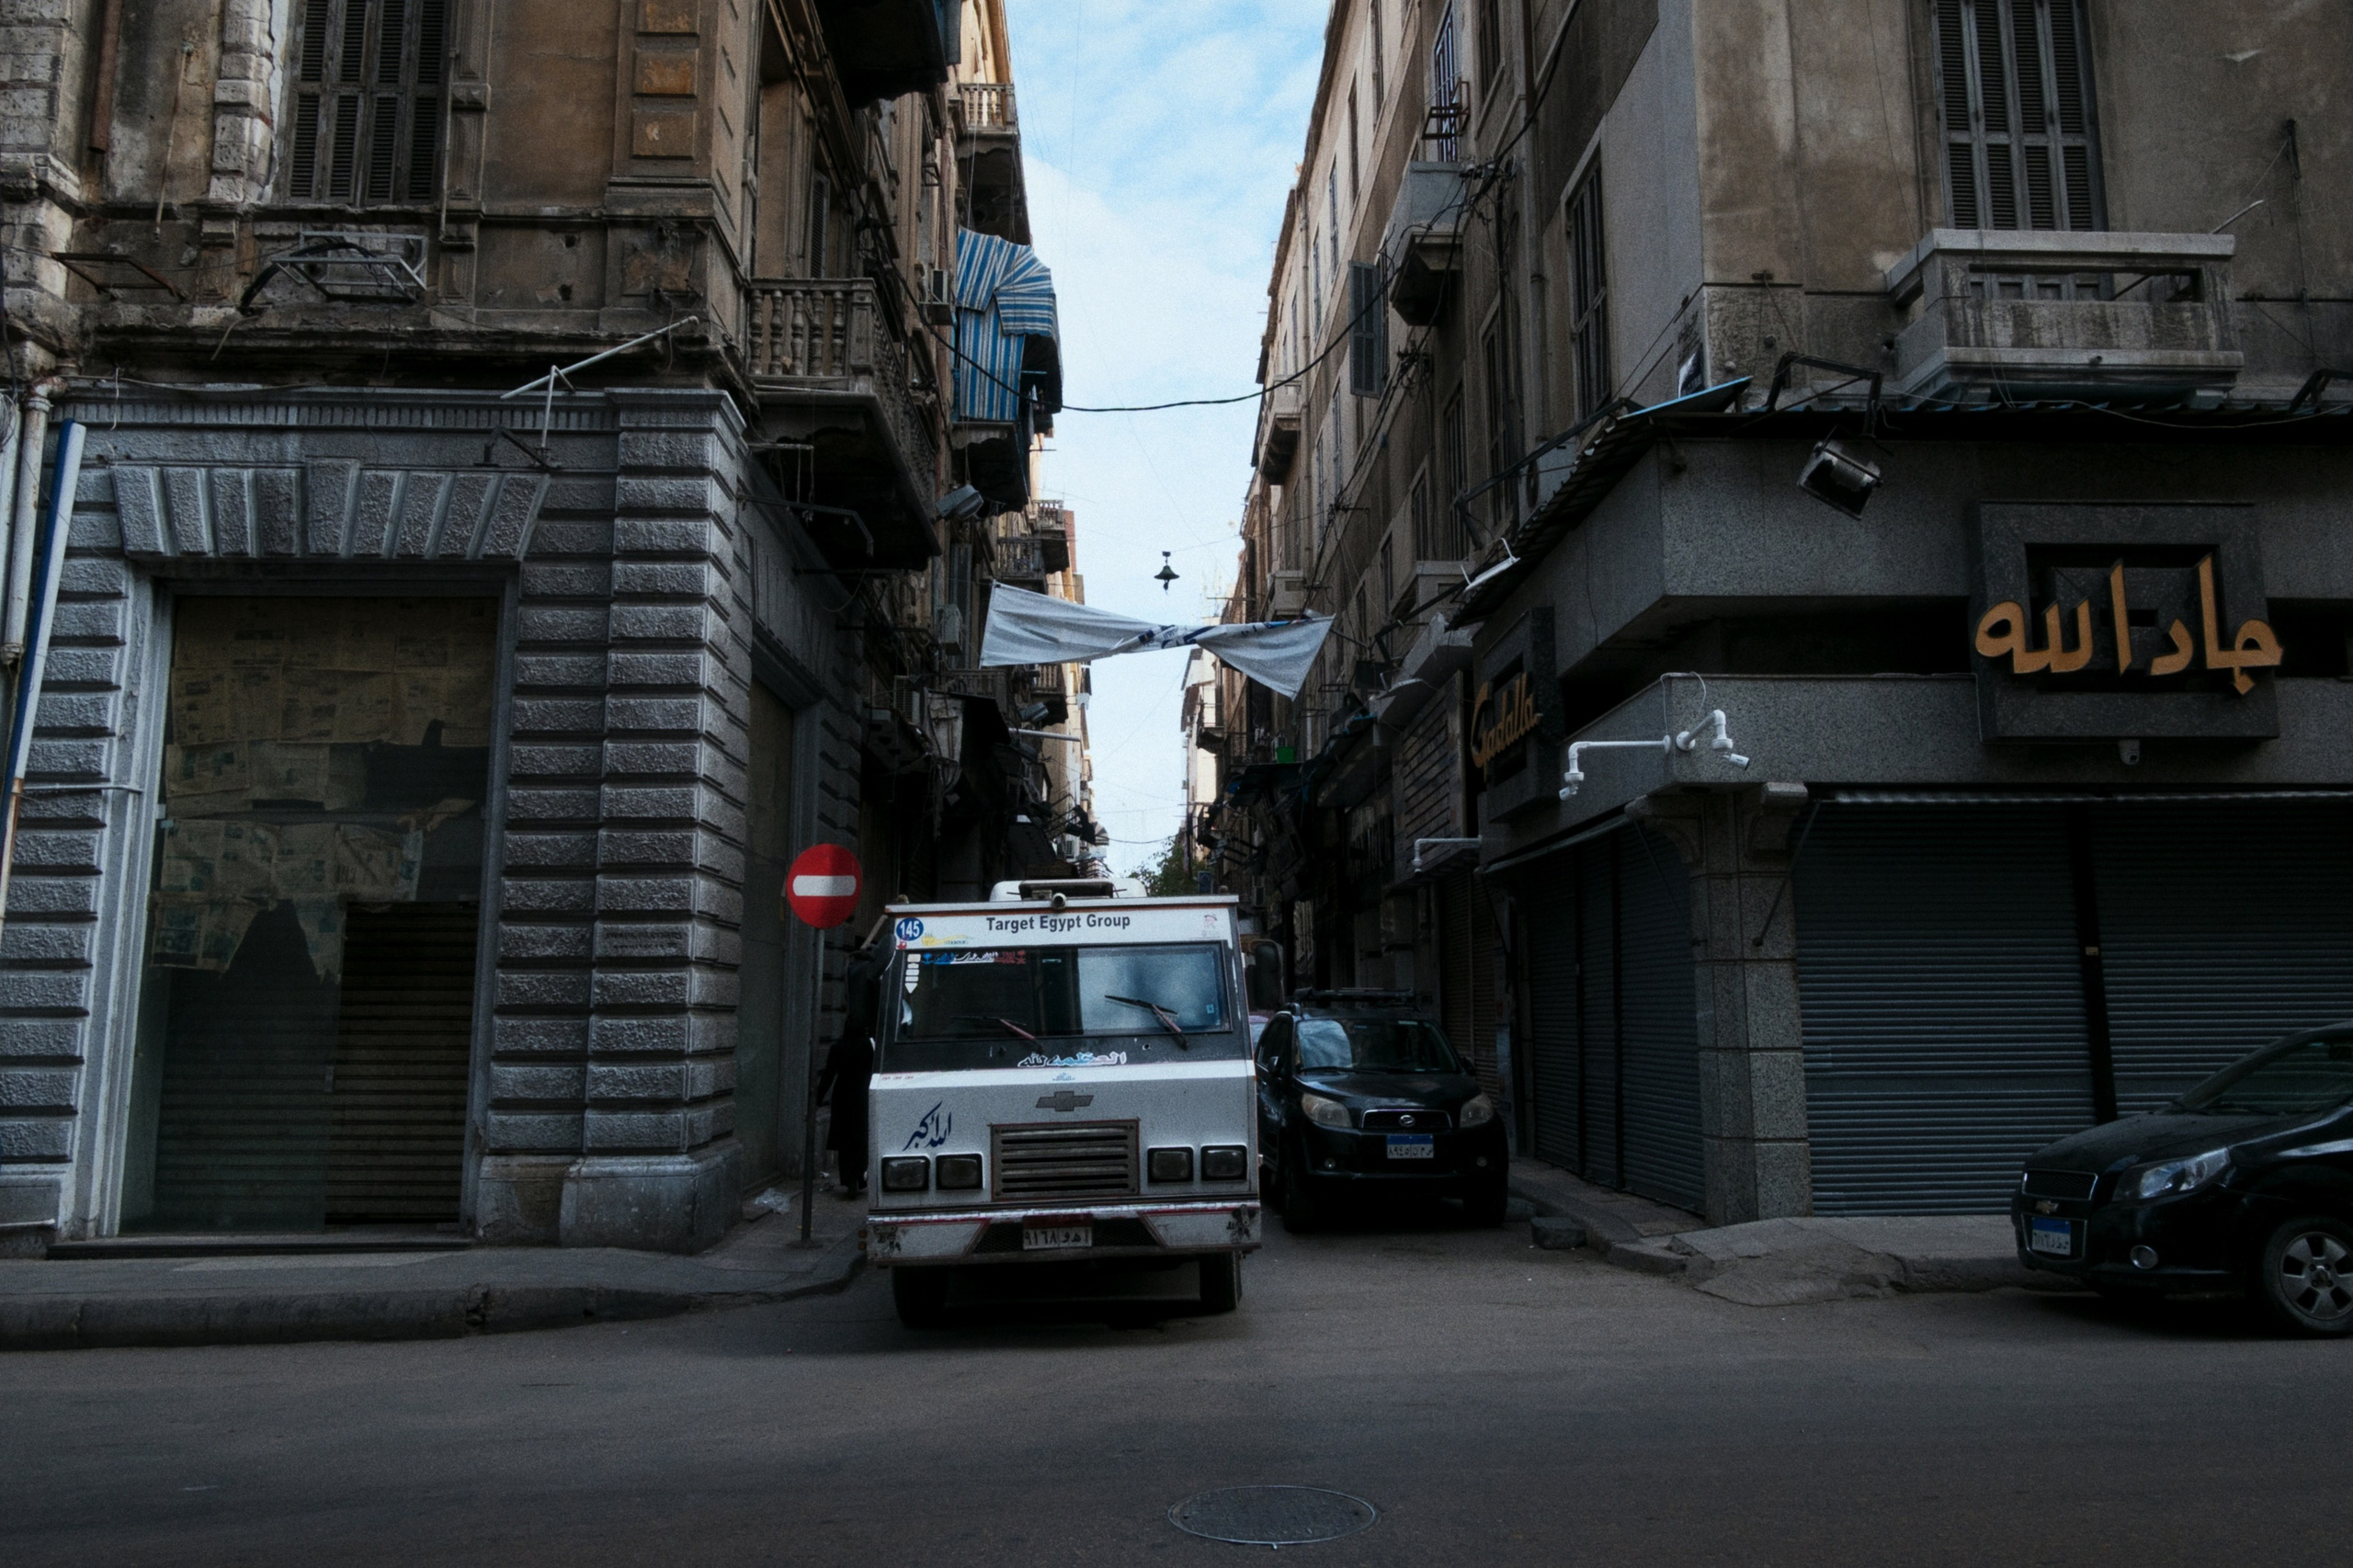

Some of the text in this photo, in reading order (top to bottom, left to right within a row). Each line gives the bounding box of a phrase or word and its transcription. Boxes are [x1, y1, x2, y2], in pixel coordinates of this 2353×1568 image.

[899, 920, 920, 937] 145
[986, 914, 1131, 934] Target Egypt Group
